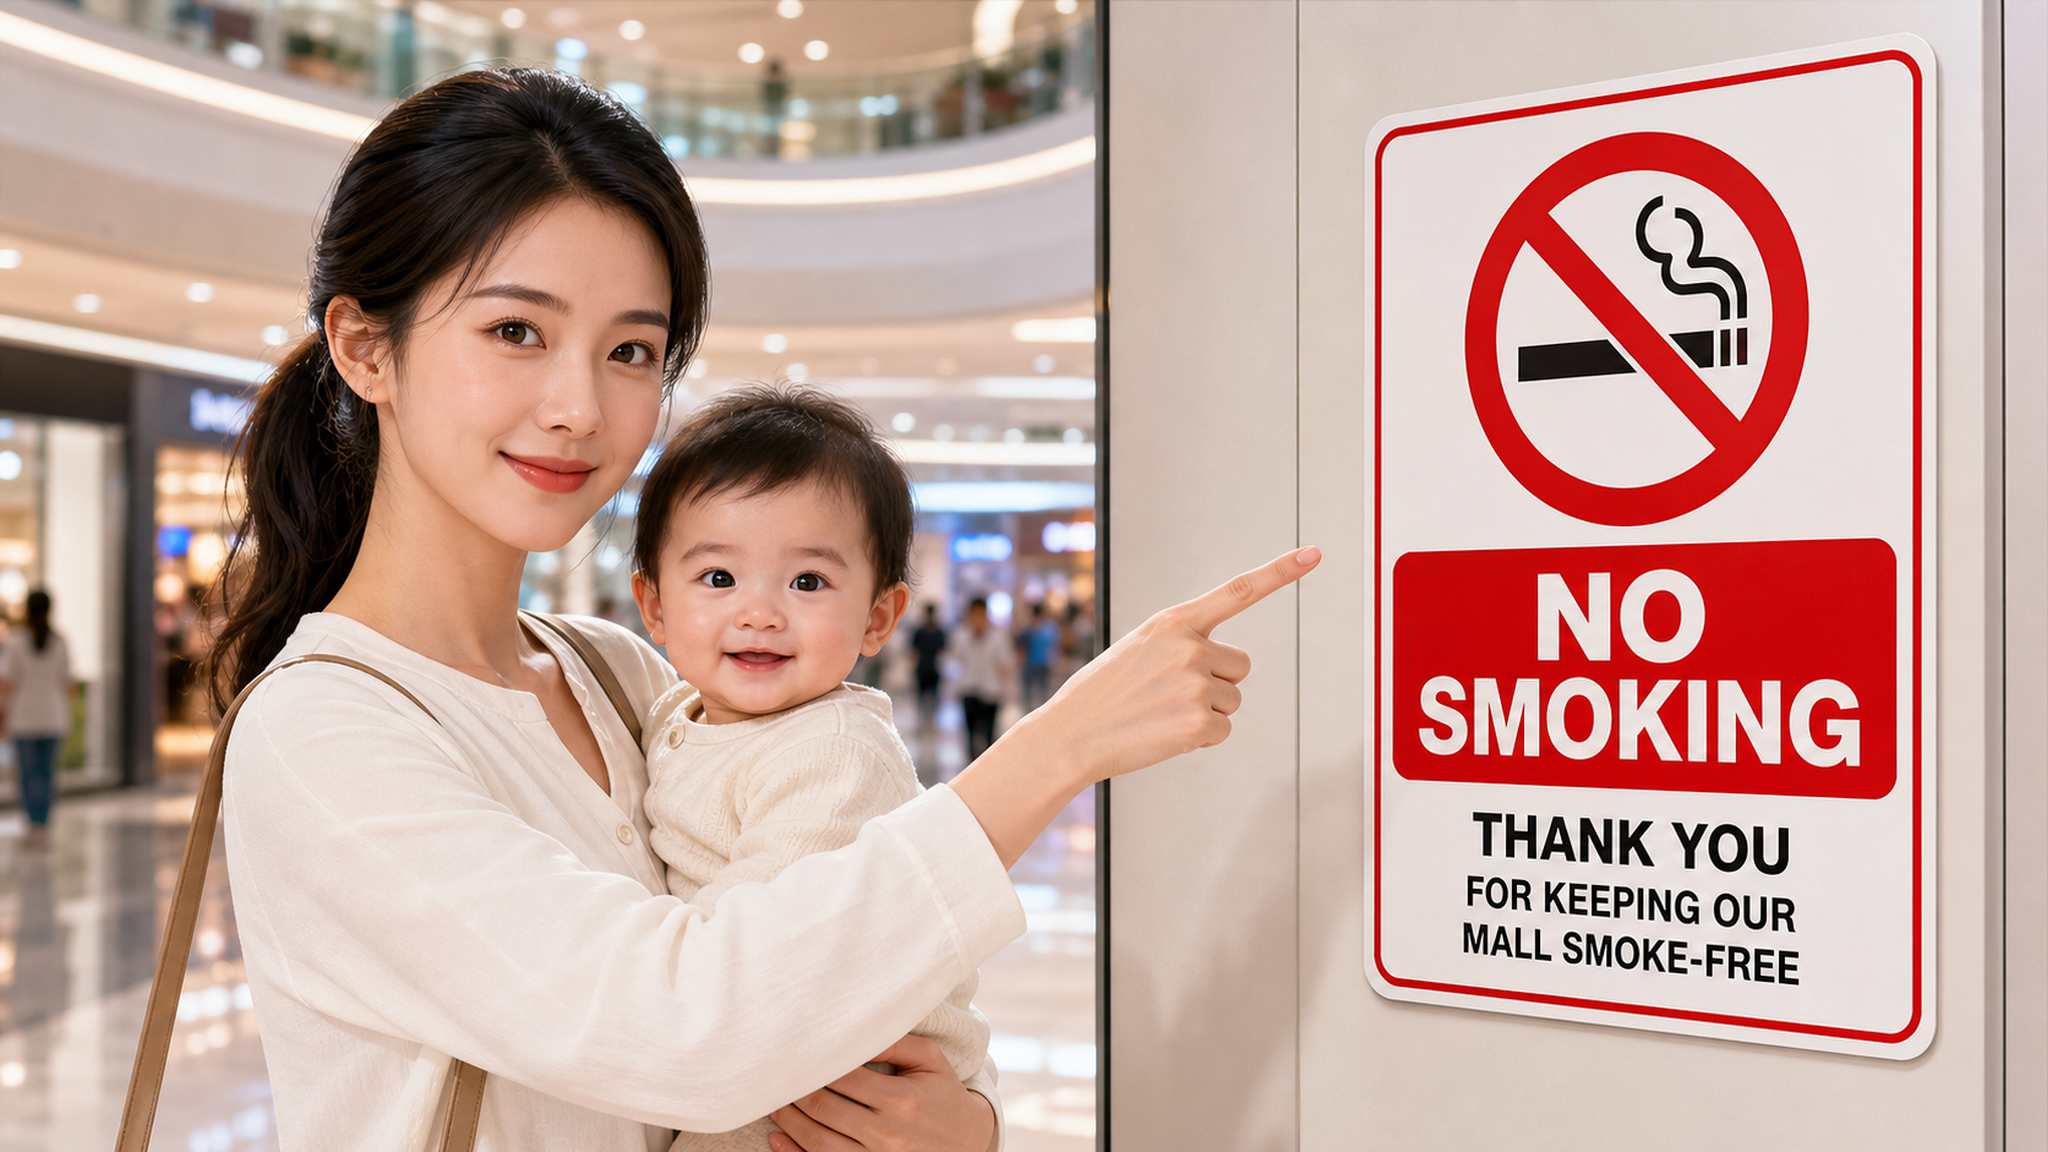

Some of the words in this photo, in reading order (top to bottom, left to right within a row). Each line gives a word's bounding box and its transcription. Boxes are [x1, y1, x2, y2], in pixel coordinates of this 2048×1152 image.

[1537, 568, 1706, 664] NO
[1418, 675, 1861, 768] SMOKING
[1472, 811, 1655, 867] THANK
[1671, 821, 1790, 876] YOU
[1466, 875, 1532, 912] FOR
[1544, 881, 1700, 925] KEEPING
[1713, 892, 1796, 933] OUR
[1463, 922, 1552, 962] MALL
[1562, 931, 1800, 986] SMOKE-FREE
